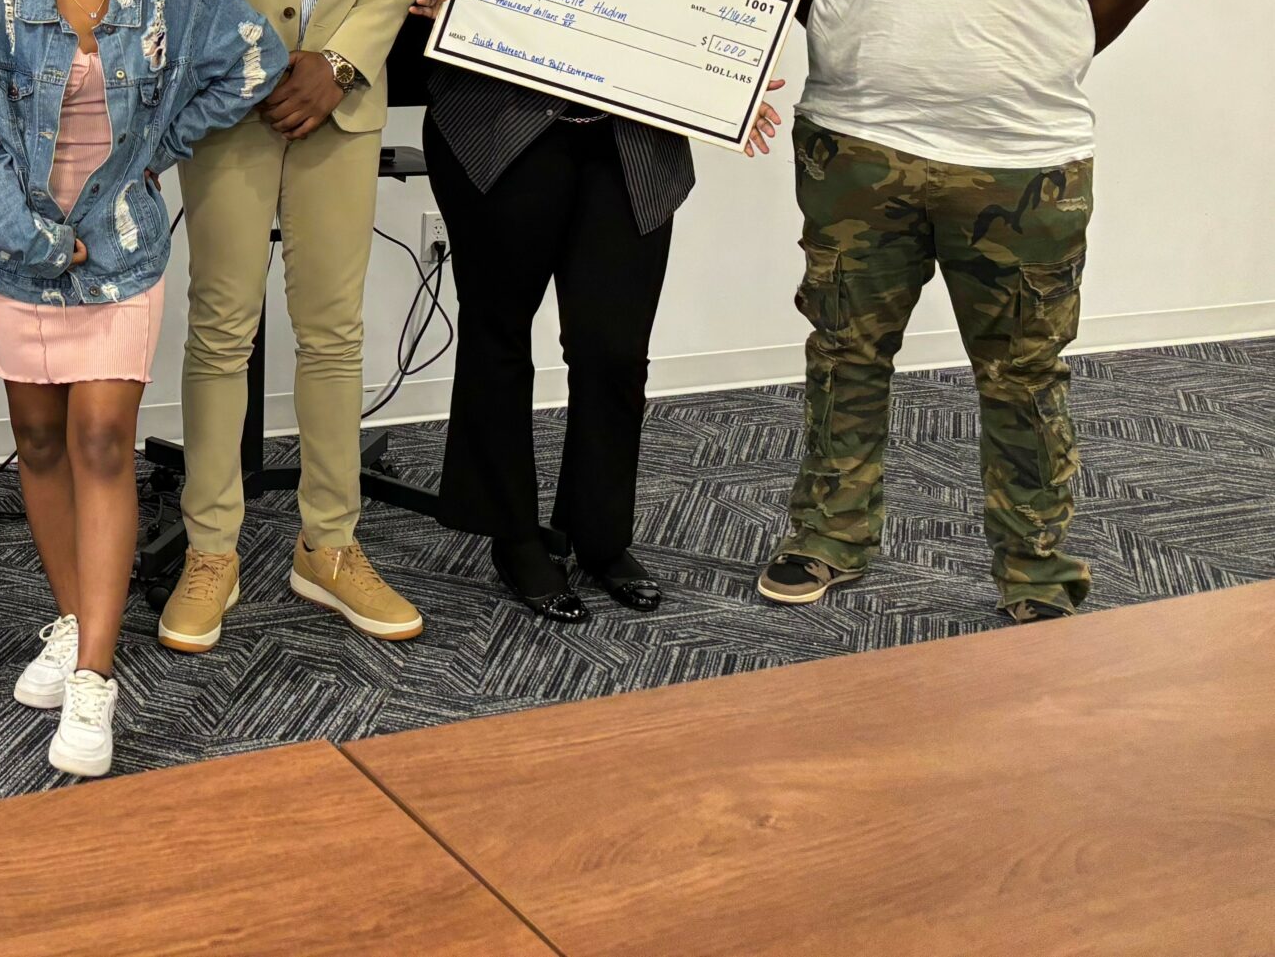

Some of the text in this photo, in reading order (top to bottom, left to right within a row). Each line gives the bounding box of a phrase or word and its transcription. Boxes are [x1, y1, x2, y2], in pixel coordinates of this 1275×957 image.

[533, 8, 559, 22] dollars
[691, 4, 706, 12] DATE
[718, 6, 756, 25] 4/16/24
[449, 31, 466, 41] MEMO
[701, 36, 708, 46] $
[472, 33, 494, 49] Guide
[497, 41, 527, 60] Outreach
[531, 54, 545, 65] and
[705, 63, 753, 84] DOLLARS
